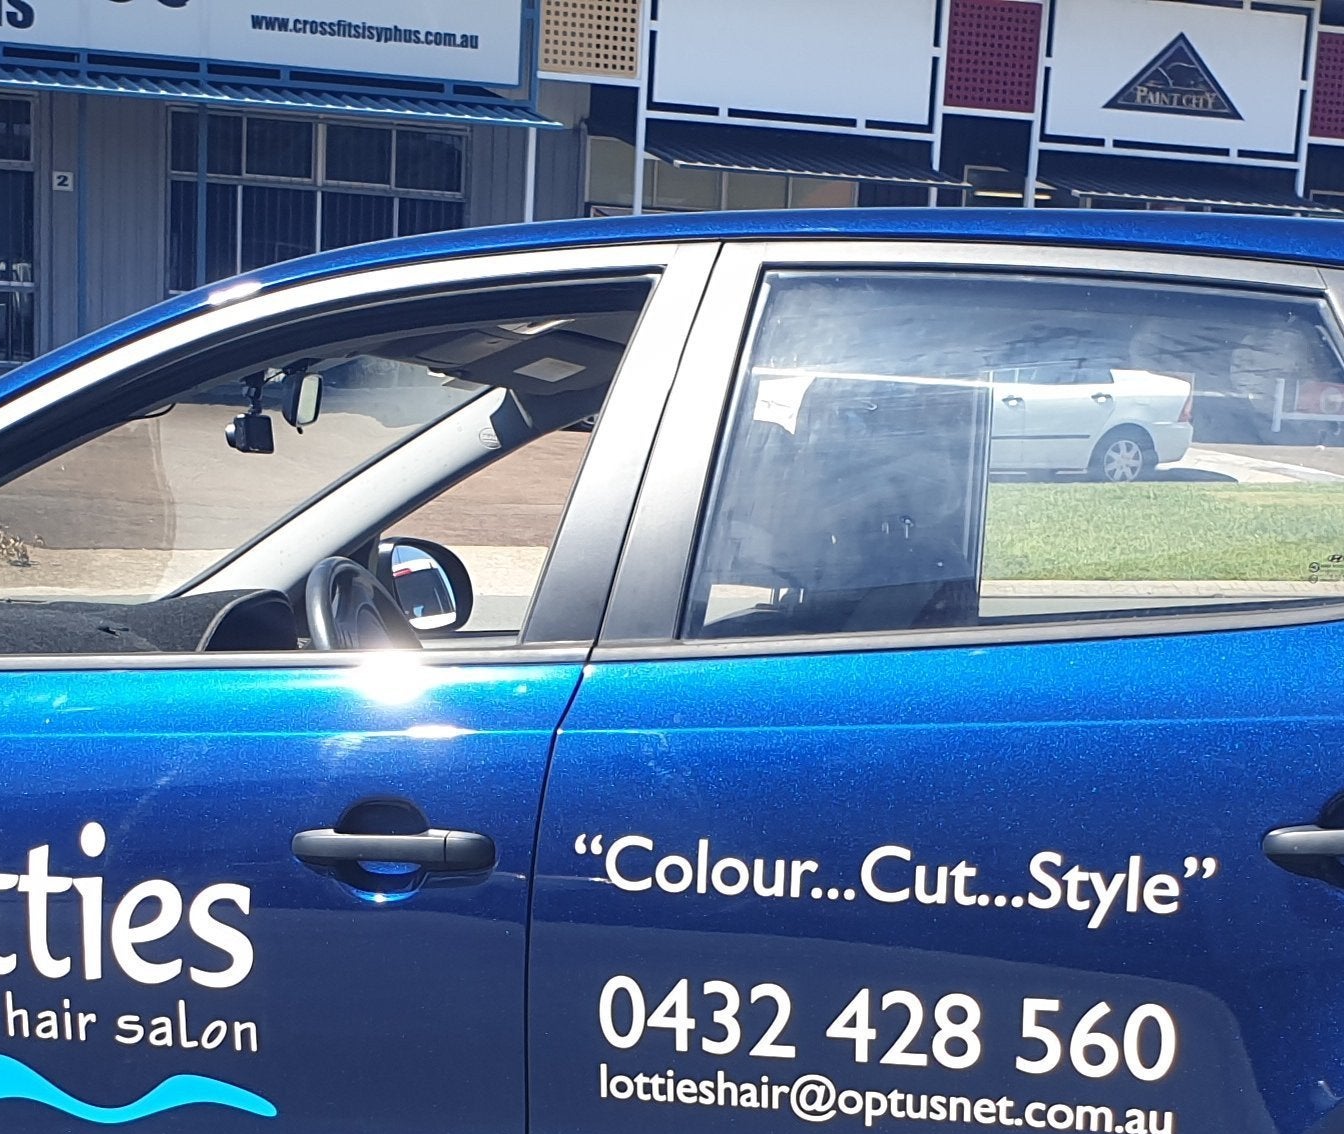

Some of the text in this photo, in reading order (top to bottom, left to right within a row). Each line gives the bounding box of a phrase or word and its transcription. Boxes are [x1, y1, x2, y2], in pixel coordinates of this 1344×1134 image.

[250, 14, 479, 50] www.crossfitsisyphus.com.au
[1135, 85, 1217, 110] PAINT CITY
[56, 174, 70, 187] 2
[5, 990, 97, 1041] hair
[114, 999, 258, 1052] salon
[599, 975, 1176, 1082] 0432 428 560
